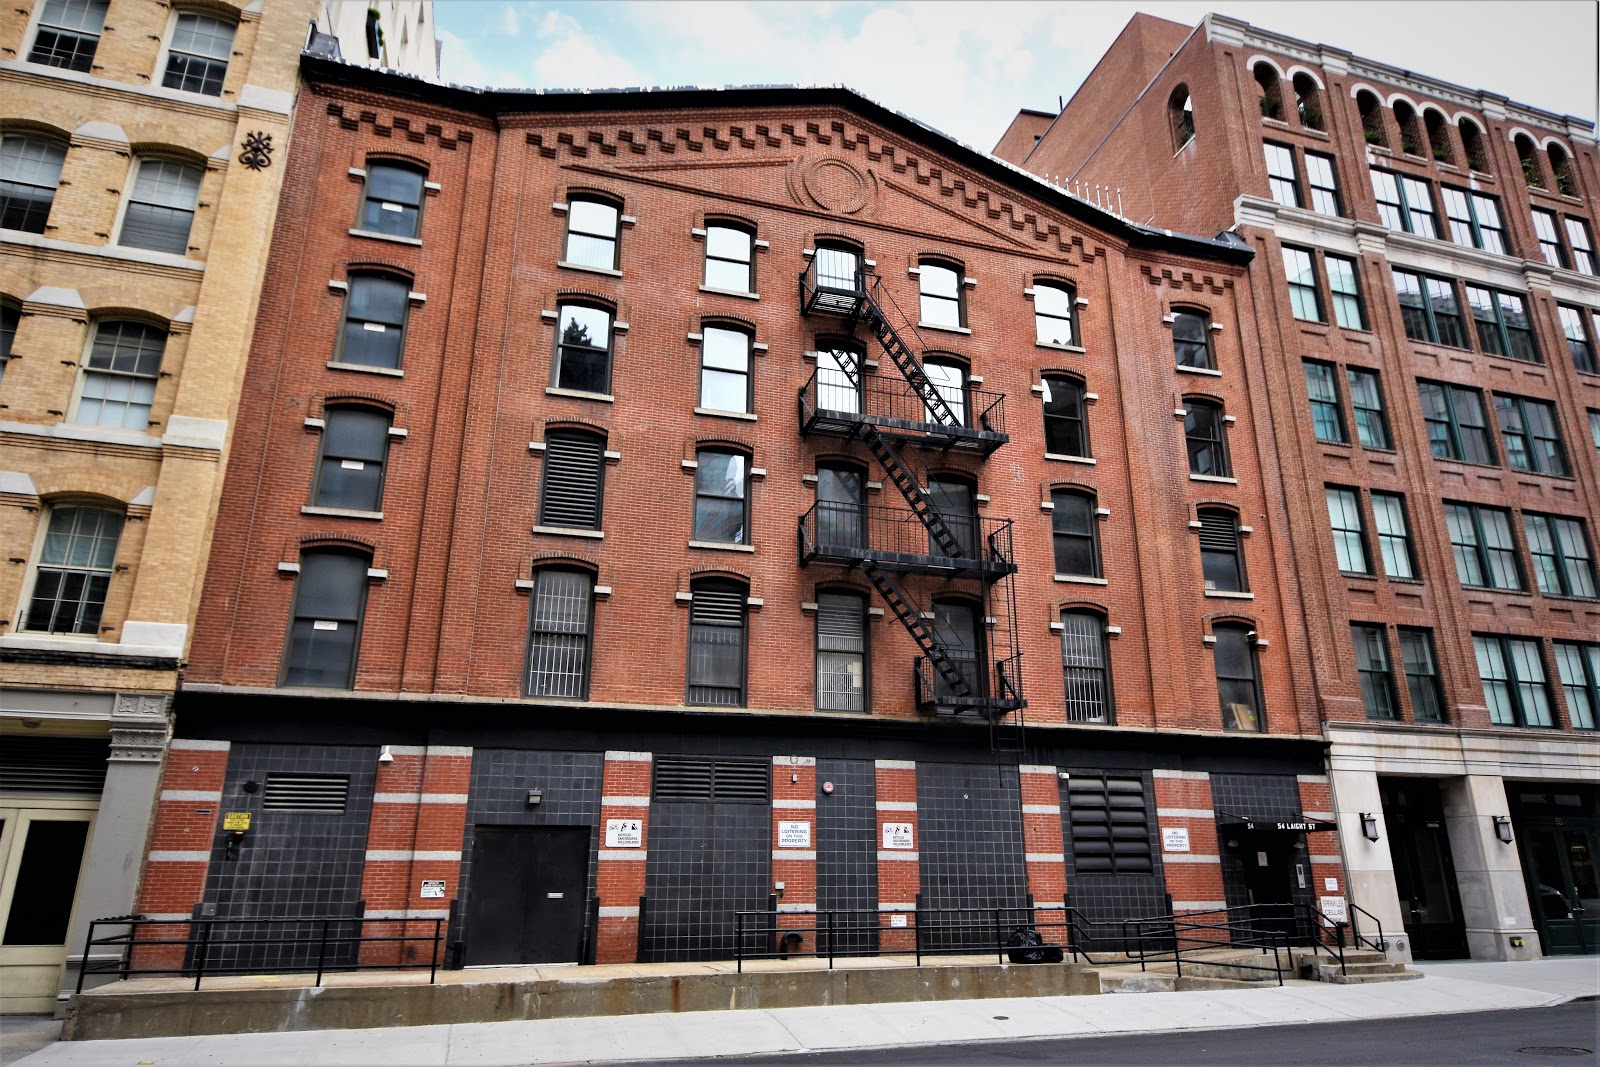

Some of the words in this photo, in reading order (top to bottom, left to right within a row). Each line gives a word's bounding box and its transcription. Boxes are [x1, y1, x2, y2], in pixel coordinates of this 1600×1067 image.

[1247, 822, 1254, 830] 54
[1277, 822, 1286, 830] 54
[1286, 822, 1306, 830] LAIGHT
[1307, 822, 1316, 830] ST
[1322, 899, 1344, 907] SPRINKLER
